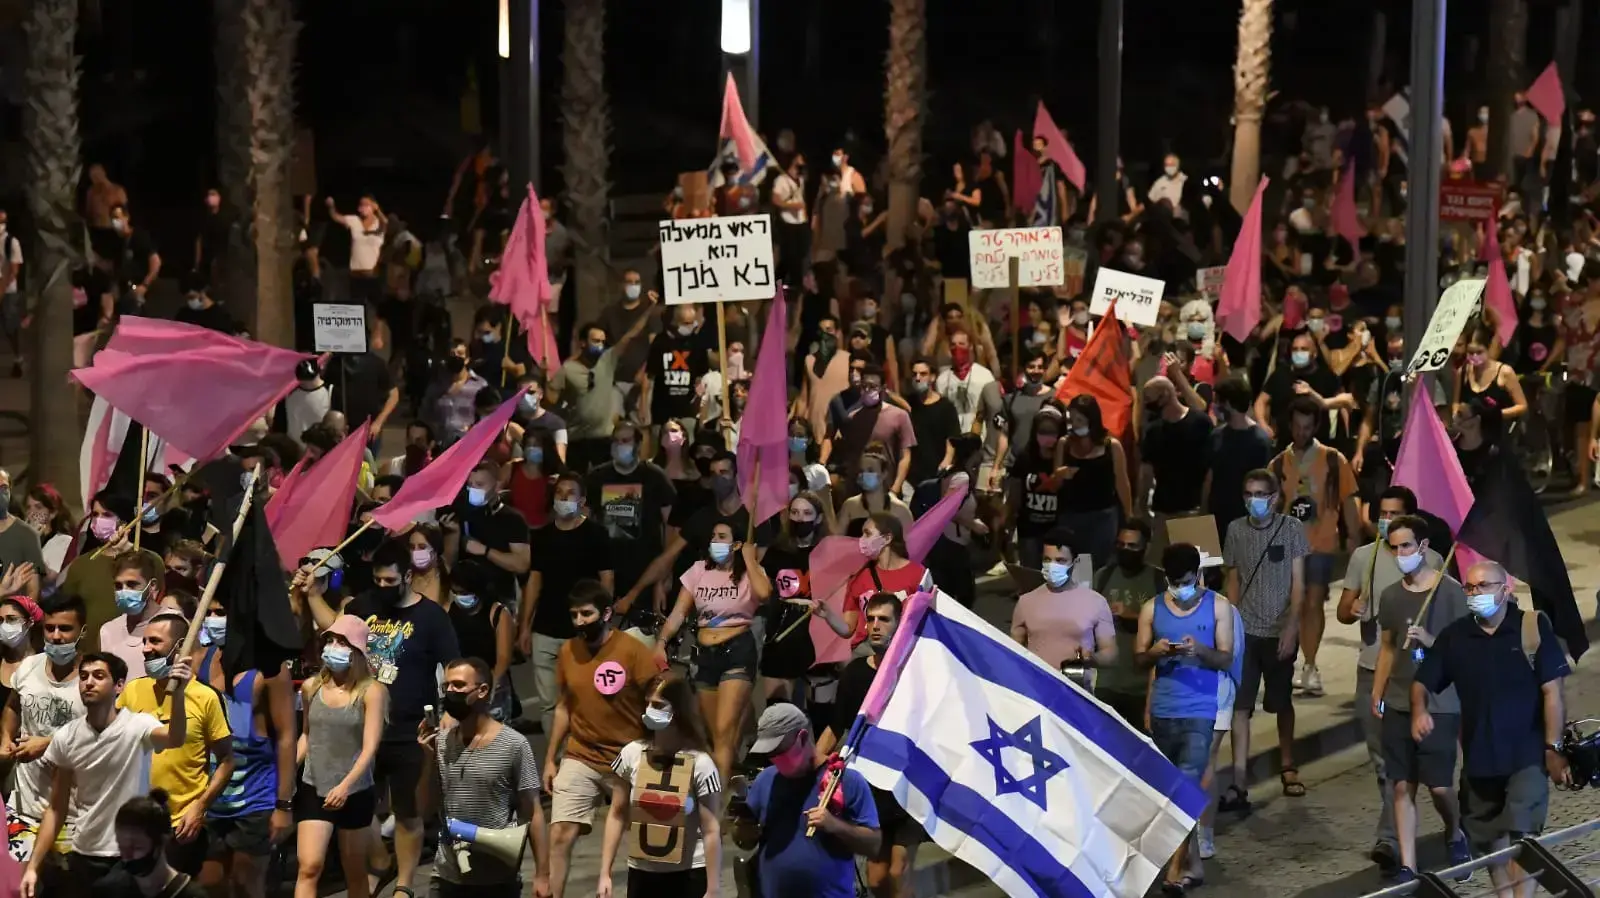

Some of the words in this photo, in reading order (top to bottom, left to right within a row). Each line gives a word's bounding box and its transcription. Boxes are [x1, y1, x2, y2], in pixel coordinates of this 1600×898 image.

[660, 220, 722, 243] ממשלה
[728, 220, 766, 237] ראש
[708, 244, 738, 260] הוא
[734, 257, 770, 287] לא
[317, 316, 363, 328] הדמוקרטיה
[664, 371, 691, 386] מצב
[1026, 493, 1058, 511] מצב
